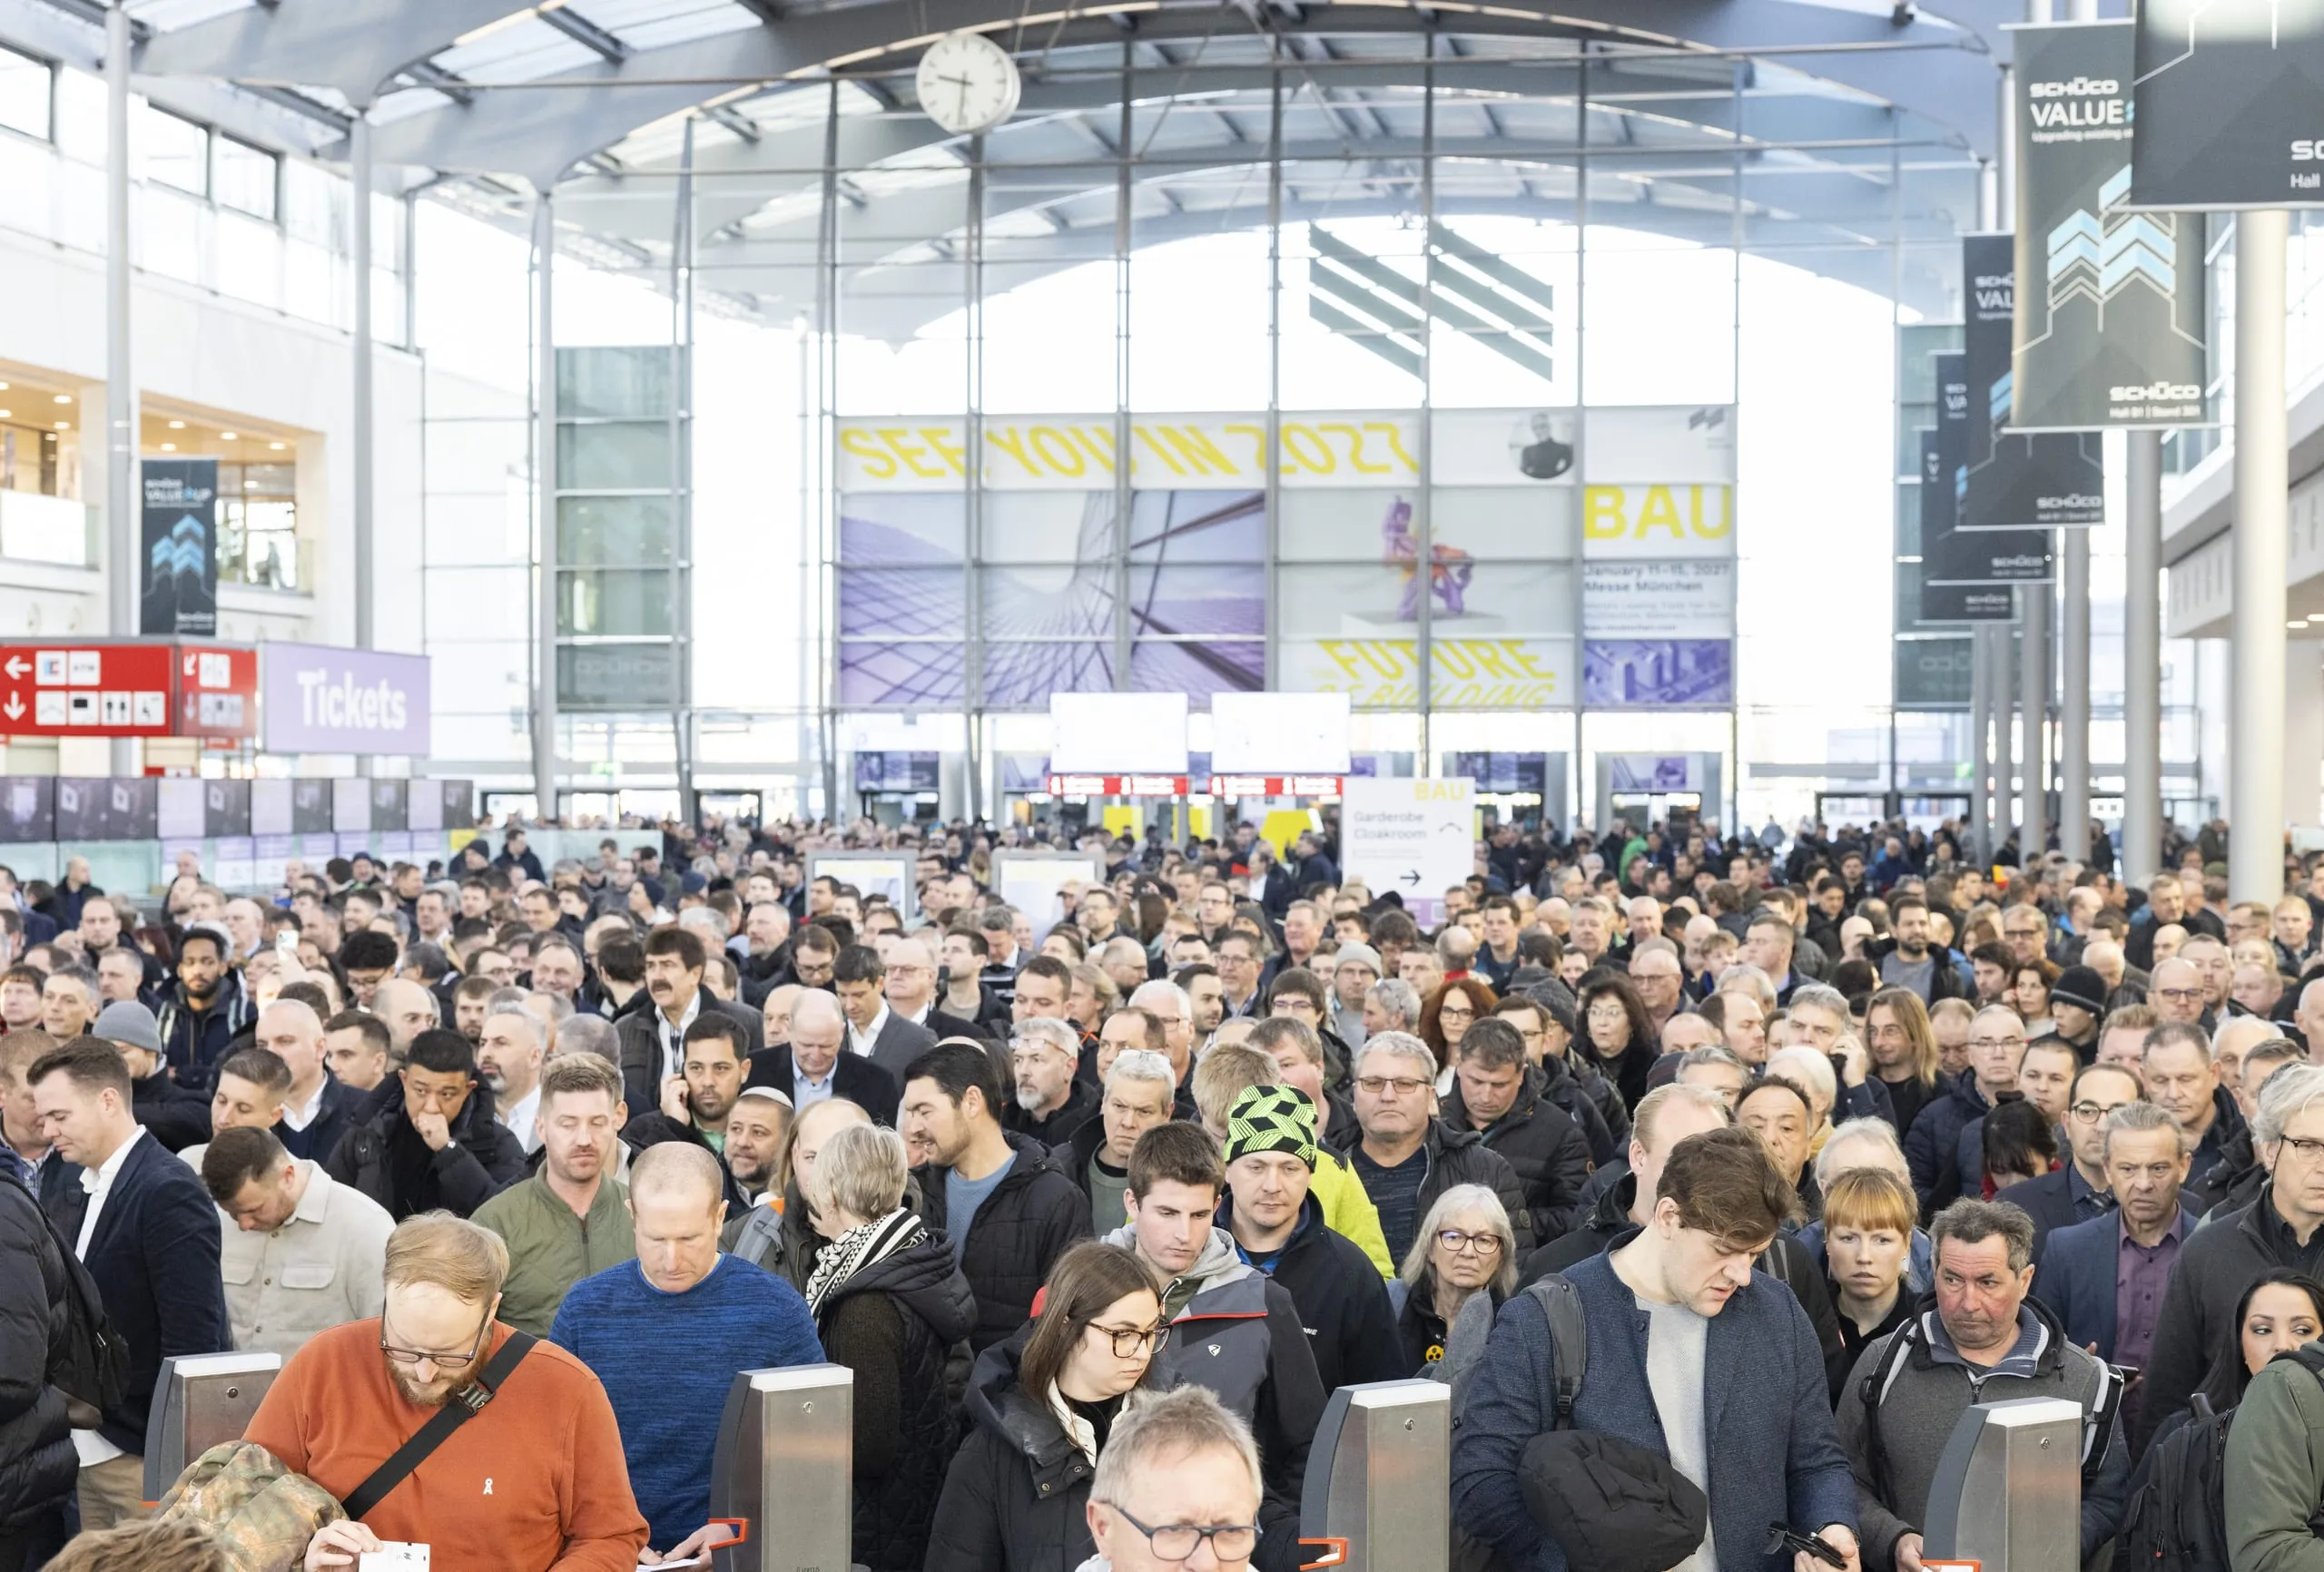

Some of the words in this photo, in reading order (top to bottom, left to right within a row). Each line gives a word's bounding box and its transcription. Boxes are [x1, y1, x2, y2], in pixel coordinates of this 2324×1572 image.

[2030, 76, 2119, 98] SCHÜCO
[2030, 99, 2124, 127] VALUE
[2290, 172, 2320, 188] Hall
[2110, 381, 2201, 401] SCHÜCO
[839, 427, 991, 479] SEE
[975, 425, 1137, 478] YOU
[1130, 424, 1241, 476] IN
[1224, 421, 1422, 477] 2027
[2036, 493, 2103, 509] SCHÜCO
[1583, 483, 1733, 541] BAU
[1585, 582, 1631, 593] Messe
[1635, 580, 1705, 592] München
[1316, 639, 1555, 681] FUTURE
[296, 666, 408, 731] Tickets
[1414, 781, 1465, 801] BAU
[1354, 811, 1425, 823] Garderobe
[1354, 828, 1427, 840] Cloakroom
